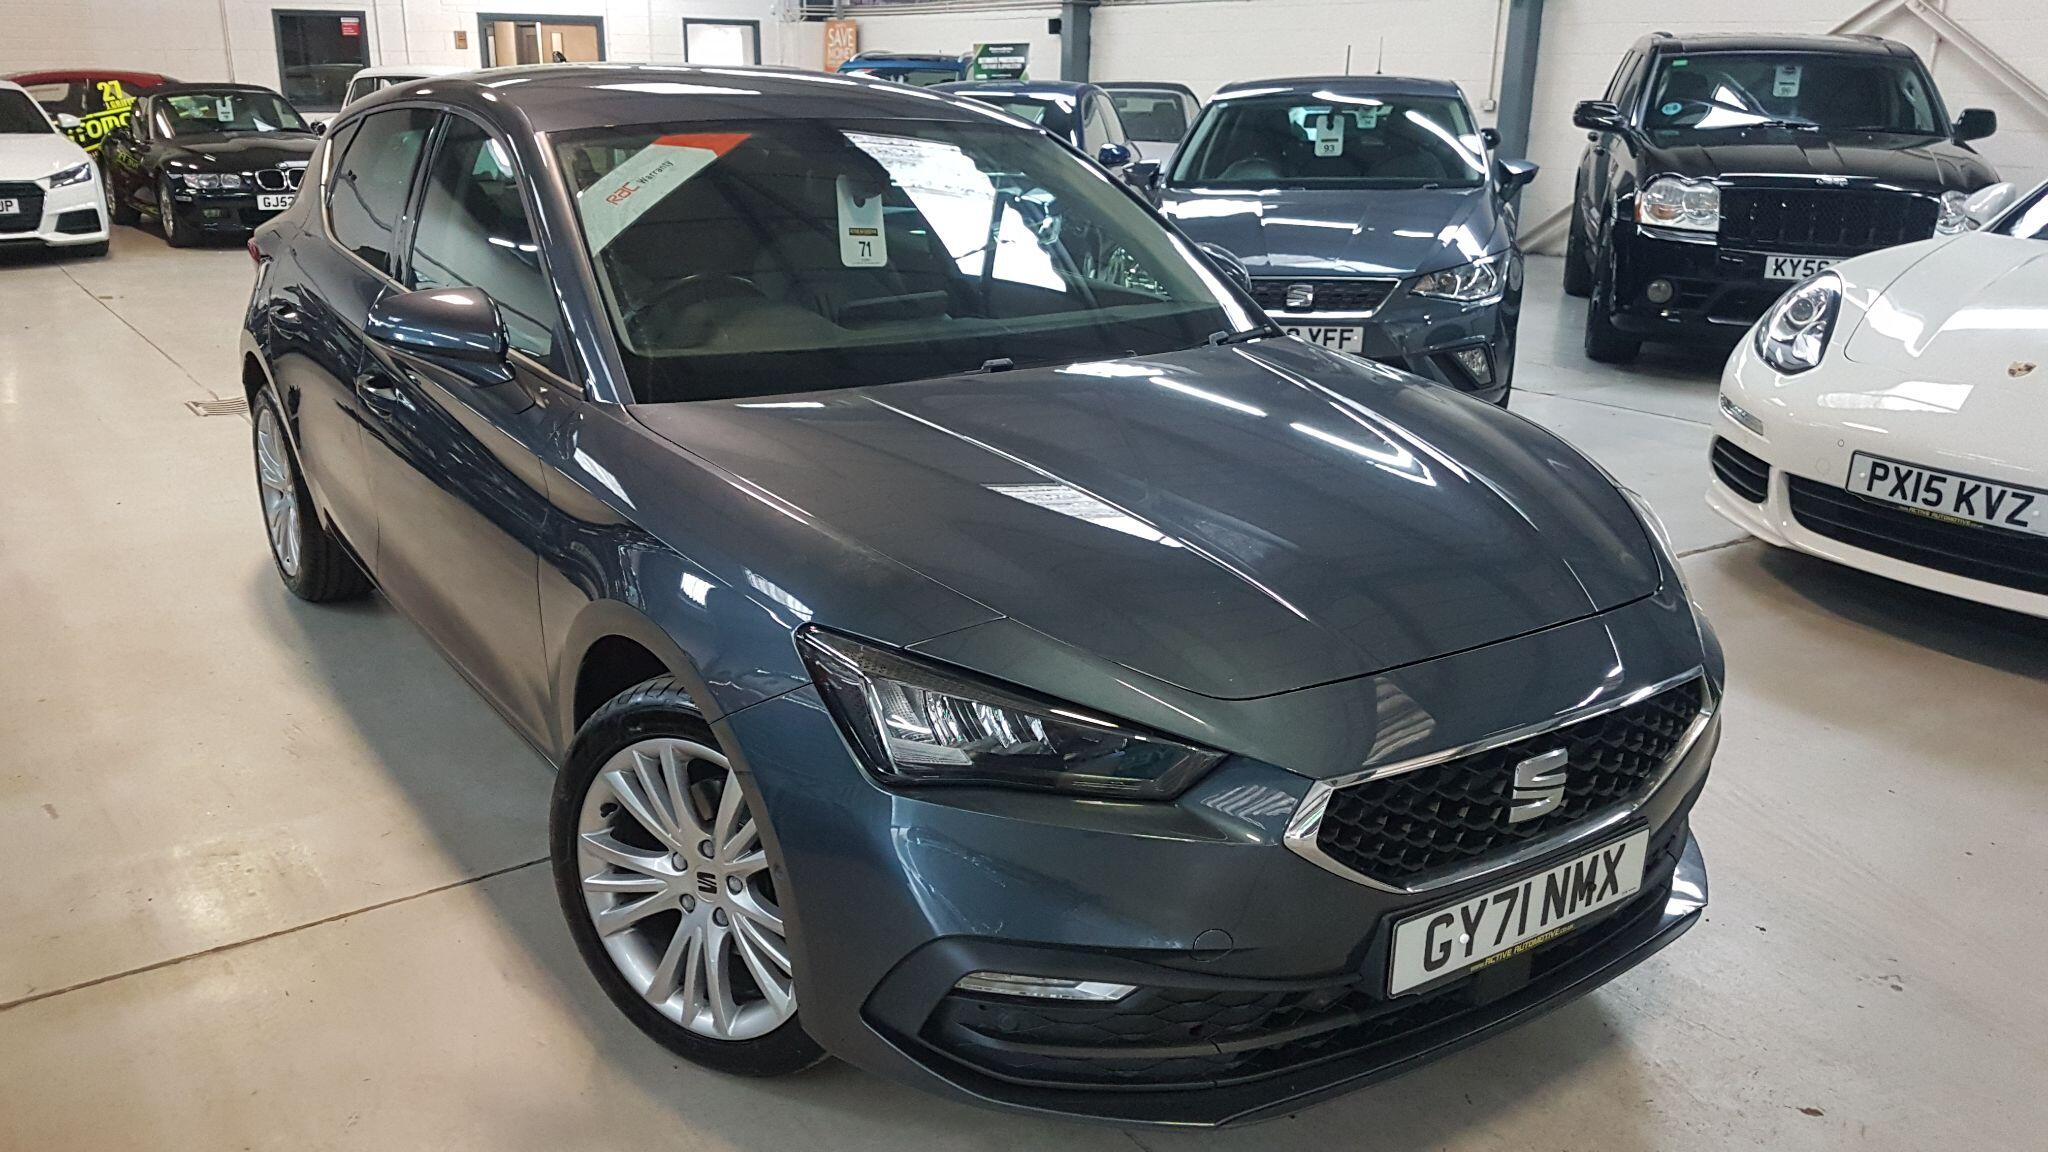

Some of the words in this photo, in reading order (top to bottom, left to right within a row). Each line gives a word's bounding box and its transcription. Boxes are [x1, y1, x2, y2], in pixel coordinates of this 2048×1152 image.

[828, 27, 854, 48] SAVE
[96, 80, 123, 102] 27
[1323, 144, 1335, 153] 93
[638, 160, 674, 184] Warranty
[858, 241, 872, 257] 71
[1866, 460, 1947, 508] PX15
[1953, 480, 2035, 528] KVZ
[1423, 880, 1533, 973] GY71
[1540, 843, 1626, 927] NMX
